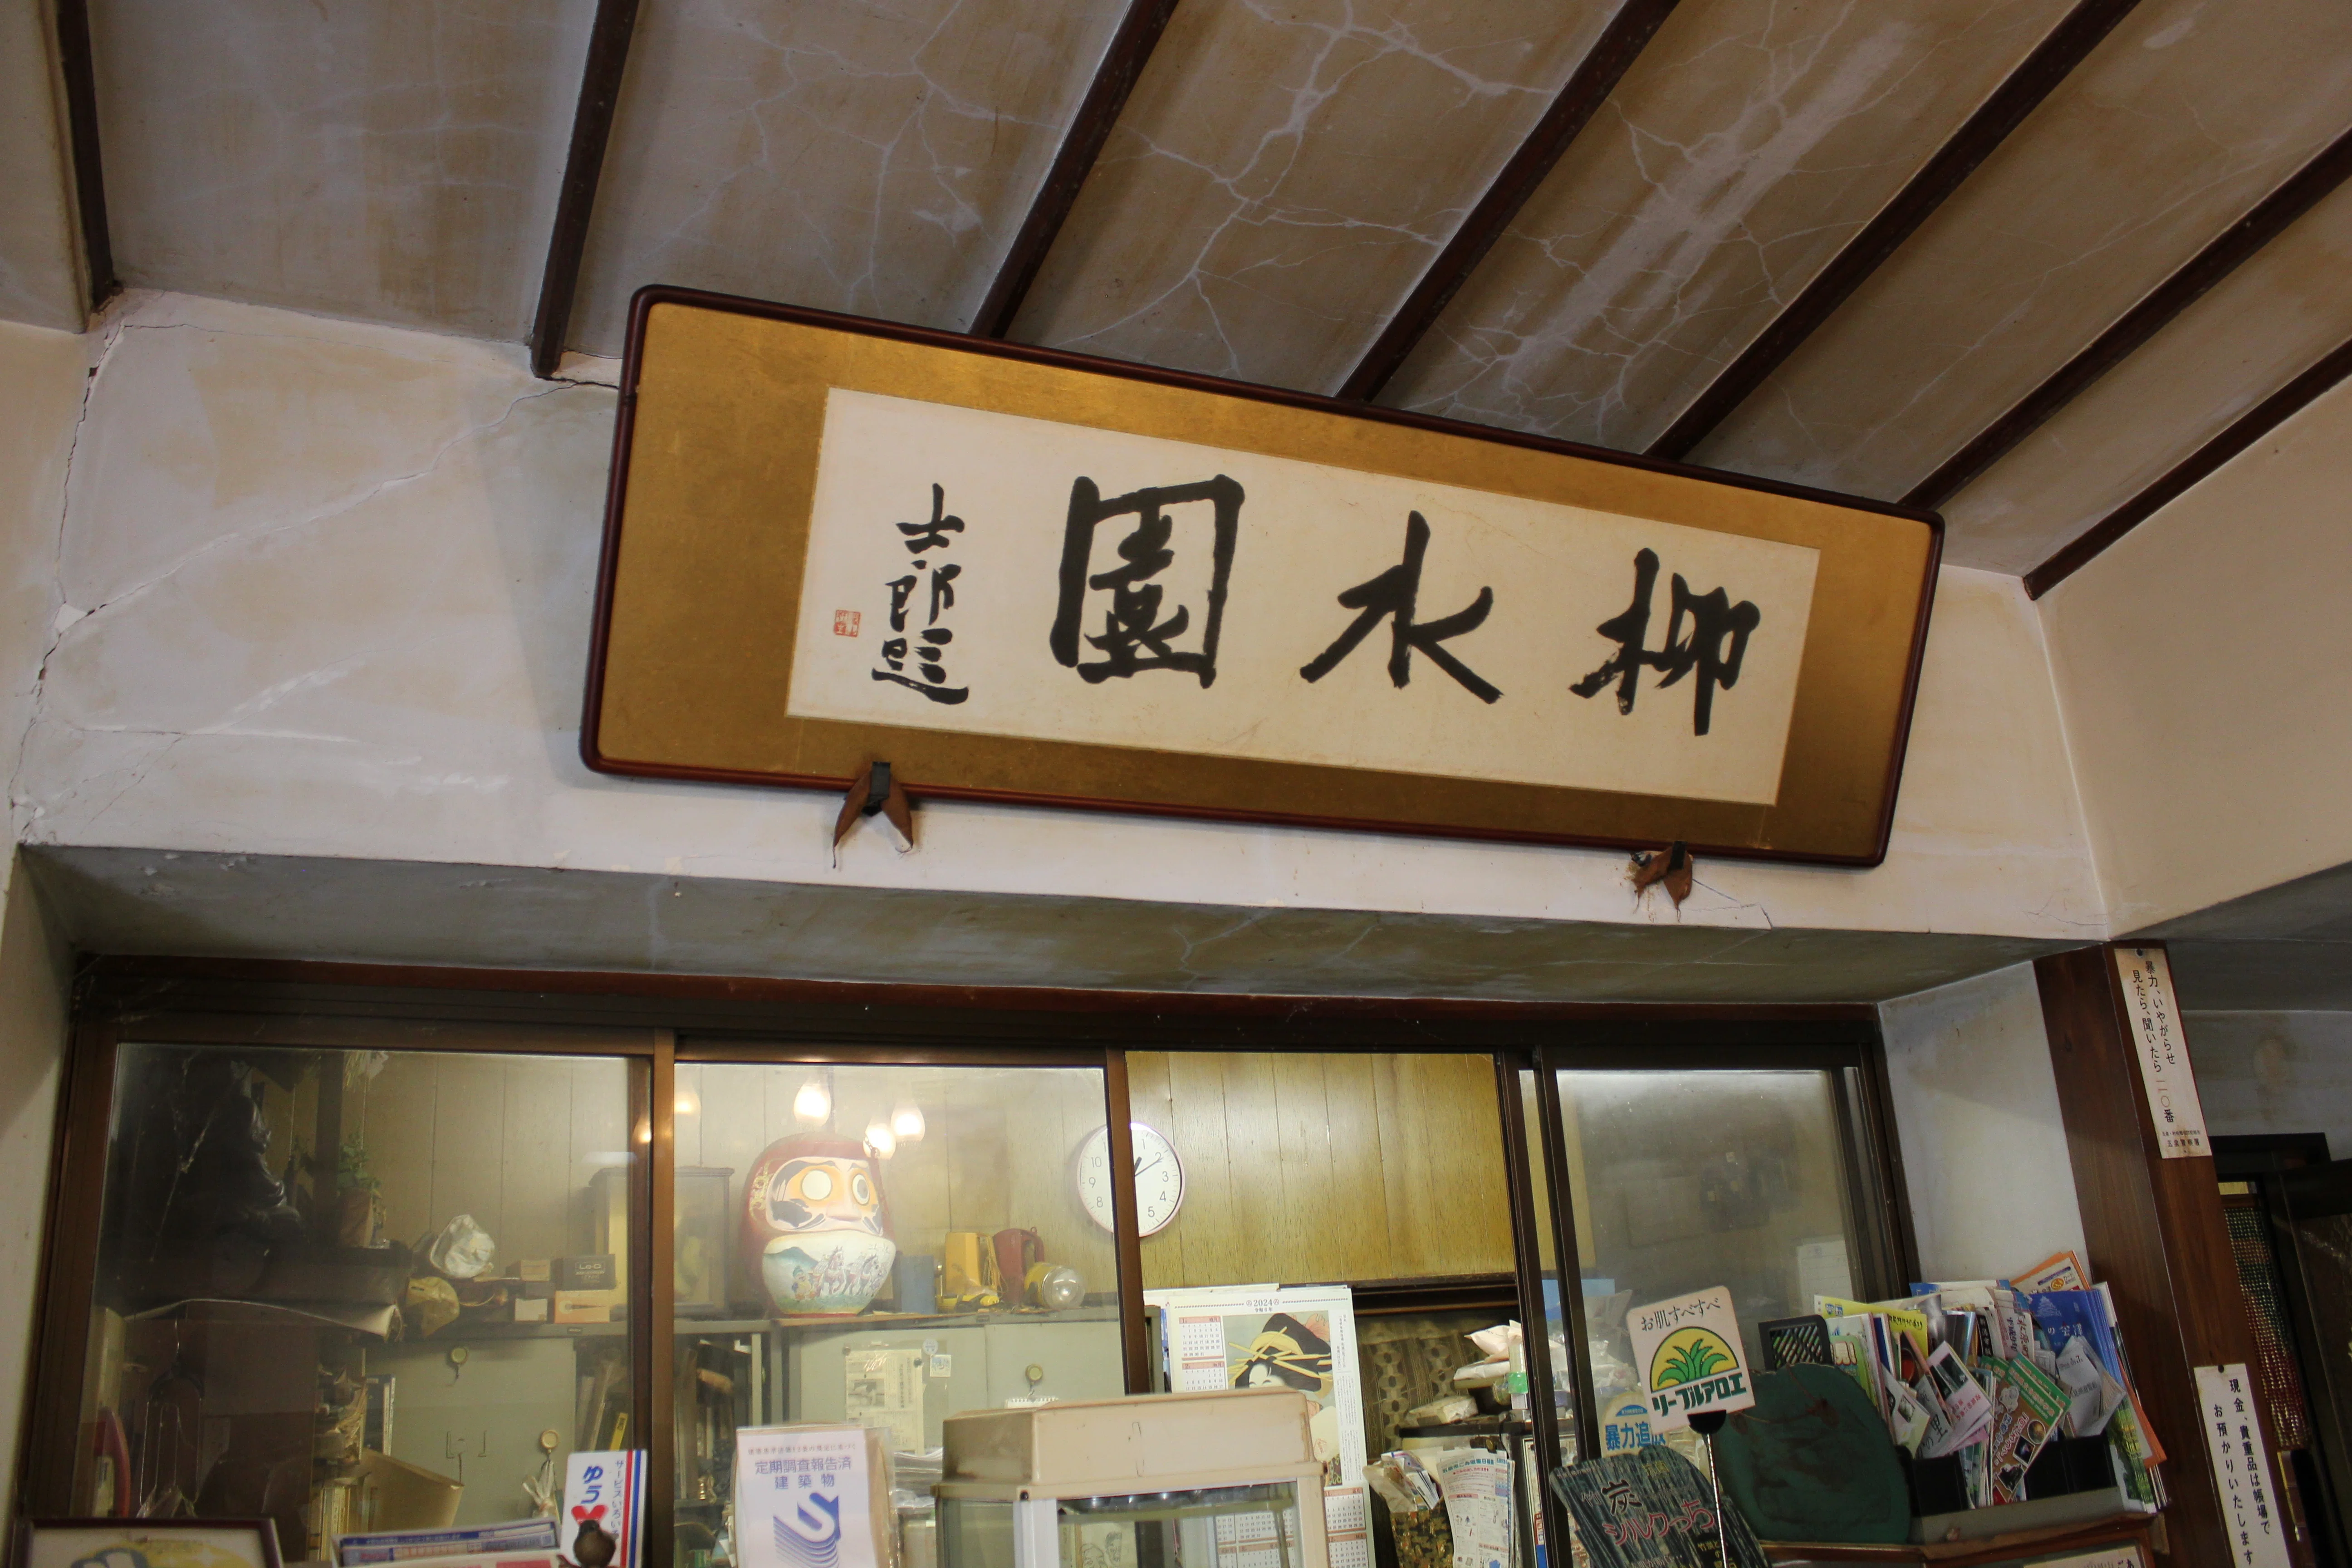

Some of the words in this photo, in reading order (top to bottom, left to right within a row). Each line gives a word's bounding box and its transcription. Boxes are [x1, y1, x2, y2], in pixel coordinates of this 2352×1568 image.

[2145, 960, 2175, 1064] 暴力、いやがらせ
[1091, 1156, 1102, 1168] 10
[1155, 1152, 1163, 1163] 2
[1089, 1177, 1096, 1188] 9
[1162, 1171, 1169, 1182] 3
[1096, 1196, 1103, 1208] 8
[1159, 1191, 1166, 1202] 4
[1147, 1206, 1155, 1218] 5
[1253, 1299, 1273, 1307] 2024
[1641, 1298, 1720, 1331] お肌すべすべ
[1651, 1372, 1747, 1417] リーブルアロエ
[2229, 1378, 2270, 1535] 現金、貴重品は帳場で
[755, 1457, 852, 1474] 定期調査報告済
[580, 1465, 603, 1504] ゆう
[774, 1474, 835, 1490] 建築物
[2214, 1404, 2253, 1565] お預かりいたします
